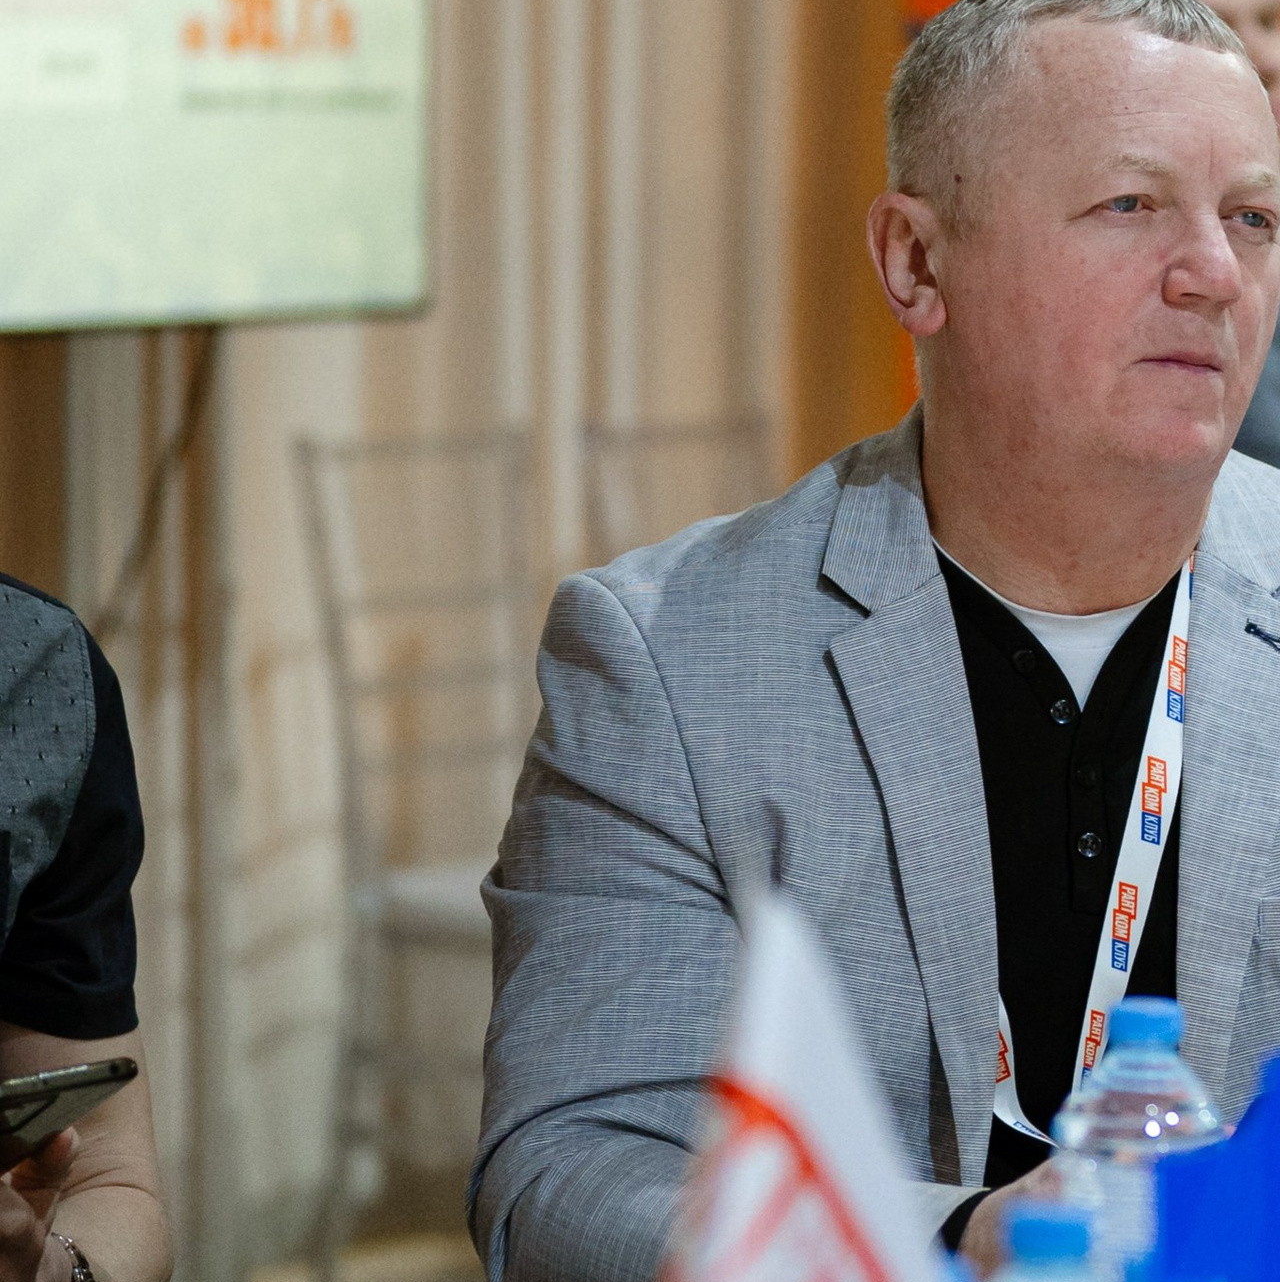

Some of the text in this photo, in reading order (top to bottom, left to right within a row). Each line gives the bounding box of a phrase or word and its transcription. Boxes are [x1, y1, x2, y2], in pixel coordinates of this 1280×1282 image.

[1169, 664, 1182, 691] KOM
[1169, 691, 1182, 721] КЛУБ
[1144, 759, 1165, 843] PART KOM КЛУБ
[1113, 885, 1136, 970] PART KOM КЛУБ
[1091, 1013, 1104, 1043] PART
[1084, 1040, 1097, 1066] KOM
